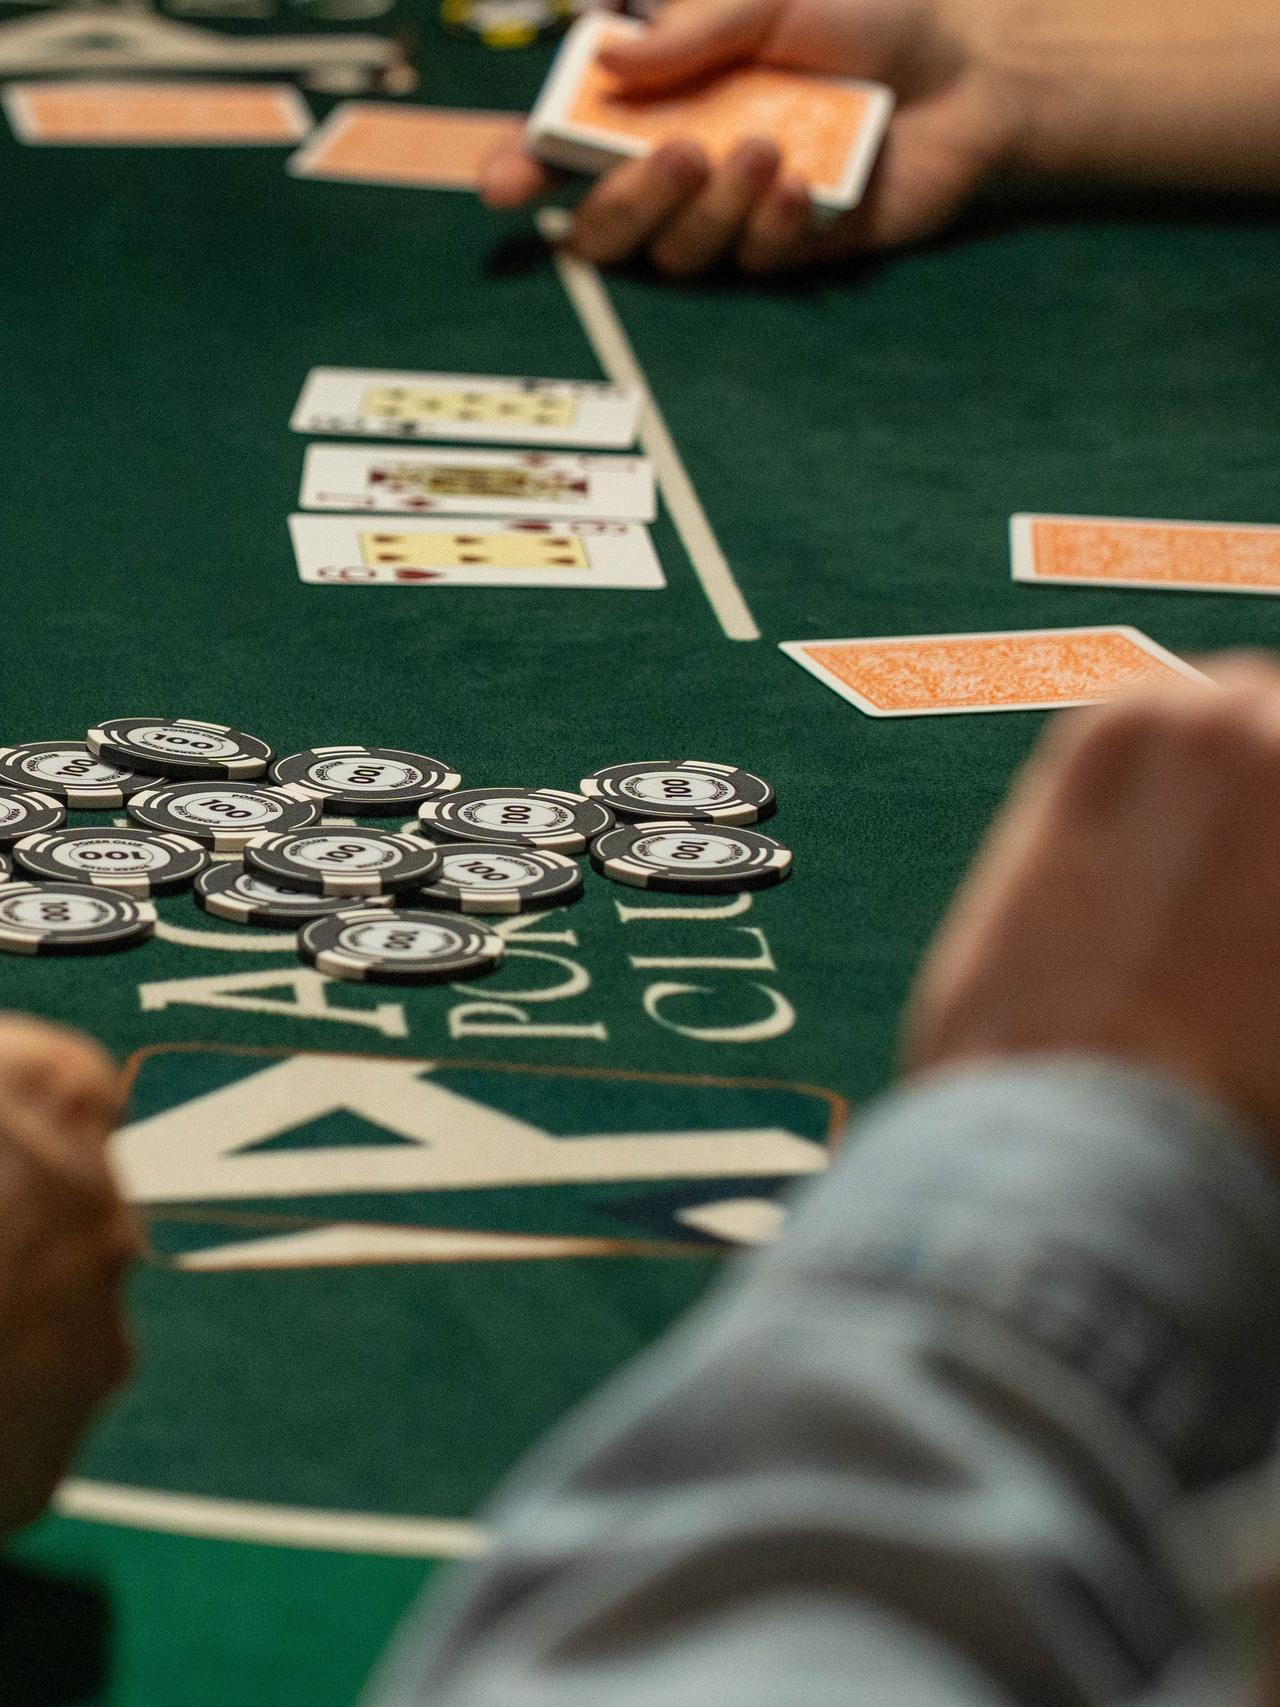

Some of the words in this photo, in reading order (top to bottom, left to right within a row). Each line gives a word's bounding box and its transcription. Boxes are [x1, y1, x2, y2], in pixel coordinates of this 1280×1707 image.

[153, 734, 214, 749] 100
[56, 759, 98, 777] 100
[347, 765, 385, 784] 100
[661, 779, 693, 798] 100
[174, 805, 188, 815] CLUB
[199, 799, 252, 818] 100
[232, 794, 267, 803] POKER
[264, 802, 278, 813] CLUB
[6, 808, 20, 821] POKER
[185, 815, 220, 824] POKER
[501, 805, 532, 824] 100
[78, 851, 146, 860] 100
[317, 844, 366, 863] 100
[671, 841, 710, 860] 100
[458, 861, 510, 880] 100
[614, 892, 797, 1041] CLU
